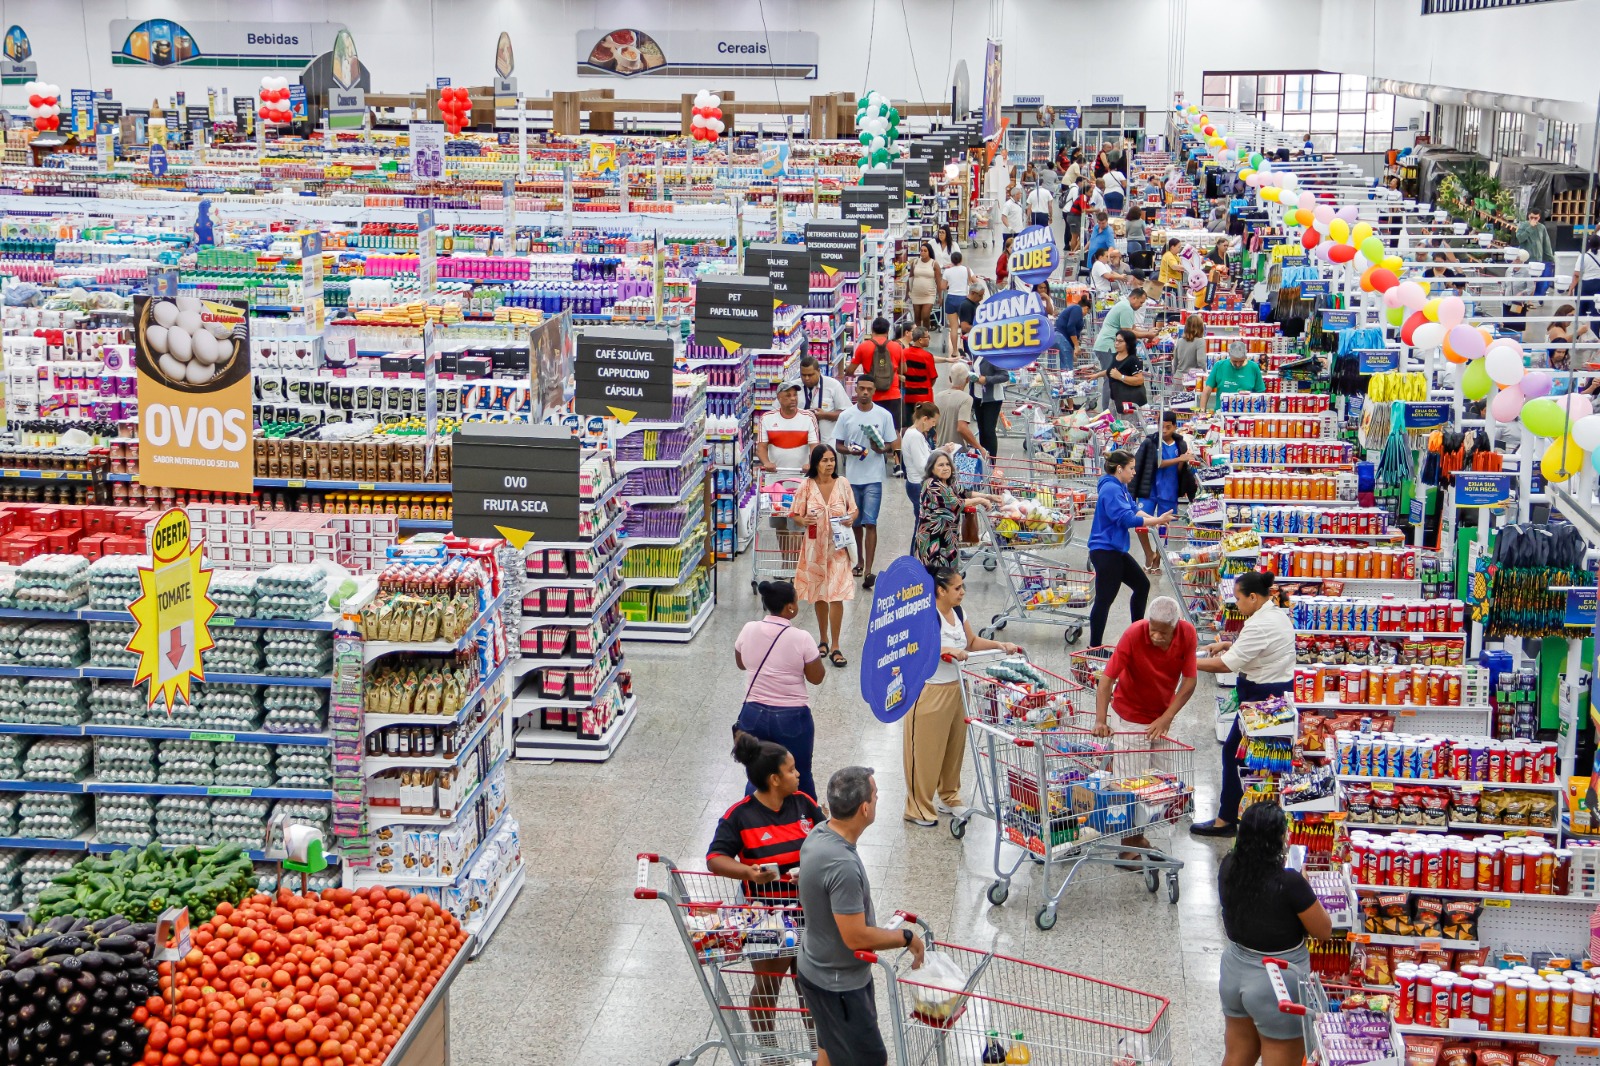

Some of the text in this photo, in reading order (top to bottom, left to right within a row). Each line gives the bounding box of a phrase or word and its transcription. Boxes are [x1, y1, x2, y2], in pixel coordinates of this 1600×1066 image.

[247, 33, 299, 45] Bebidas
[717, 41, 767, 55] Cereais
[806, 230, 859, 239] DETERGENTE LÍQUIDO
[1013, 226, 1053, 251] GUANA
[807, 242, 857, 250] DESENGORDURANTE
[767, 258, 789, 266] TALHER
[821, 252, 843, 260] ESPONJA
[1011, 246, 1053, 272] CLUBE
[769, 271, 785, 279] POTE
[728, 293, 742, 301] PET
[709, 307, 759, 318] PAPEL TOALHA
[975, 291, 1043, 324] GUANA
[972, 319, 1040, 351] CLUBE
[595, 348, 654, 362] CAFÉ SOLÚVEL
[597, 367, 650, 380] CAPPUCCINO
[605, 384, 643, 397] CÁPSULA
[145, 403, 247, 452] OVOS
[153, 455, 239, 468] SABOR NUTRITIVO DO SEU DIA
[504, 476, 527, 489] OVO
[483, 498, 549, 513] FRUTA SECA
[156, 520, 188, 551] OFERTA
[157, 581, 192, 612] TOMATE
[877, 593, 896, 614] Preços
[902, 583, 924, 602] baixos
[869, 594, 931, 633] e muitas vantagens!
[886, 628, 909, 649] Faça seu
[877, 641, 919, 669] cadastro no App.
[886, 687, 904, 709] CLUBE
[1409, 1046, 1434, 1054] FRONTERA
[1484, 1052, 1510, 1061] FRONTERA
[1519, 1053, 1546, 1063] FRONTERA
